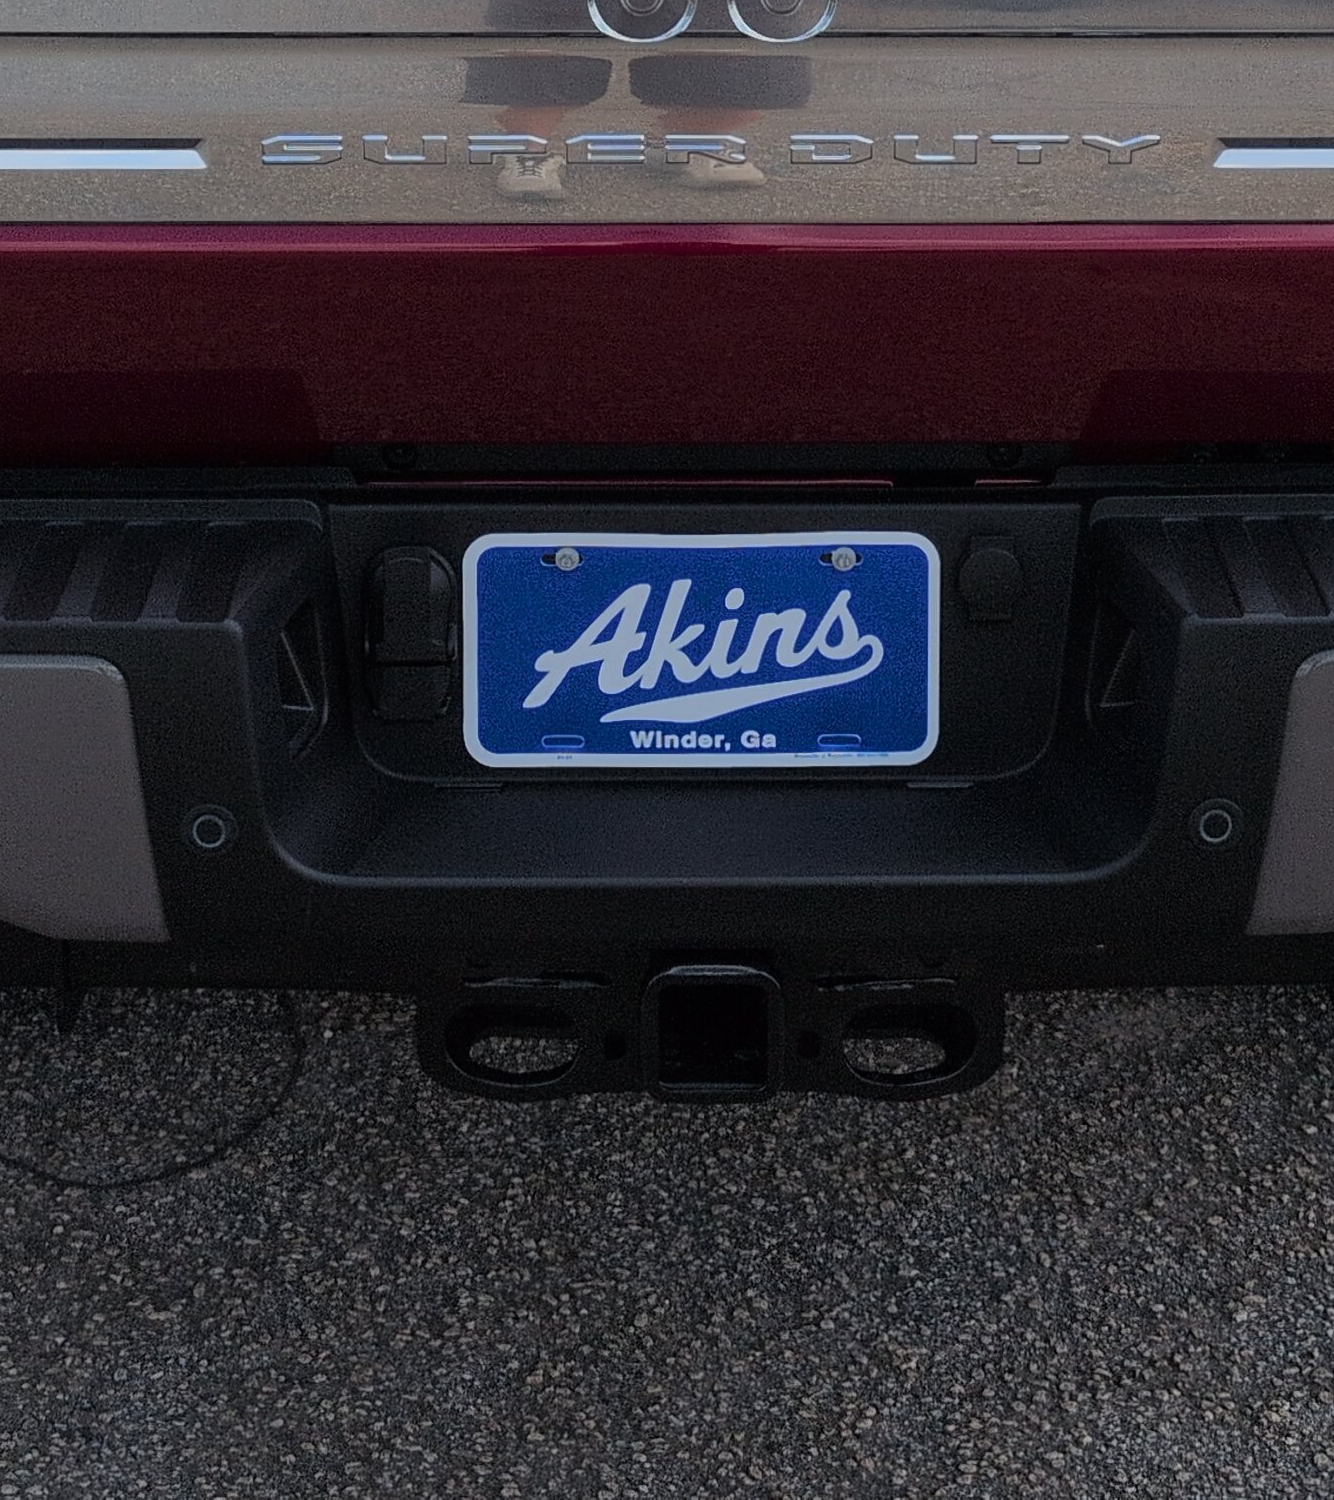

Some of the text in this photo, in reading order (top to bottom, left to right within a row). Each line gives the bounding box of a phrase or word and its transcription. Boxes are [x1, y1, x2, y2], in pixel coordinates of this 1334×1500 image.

[261, 133, 1162, 165] SUPER DUTY
[522, 579, 884, 723] Akins
[629, 730, 777, 752] Winder, Ga
